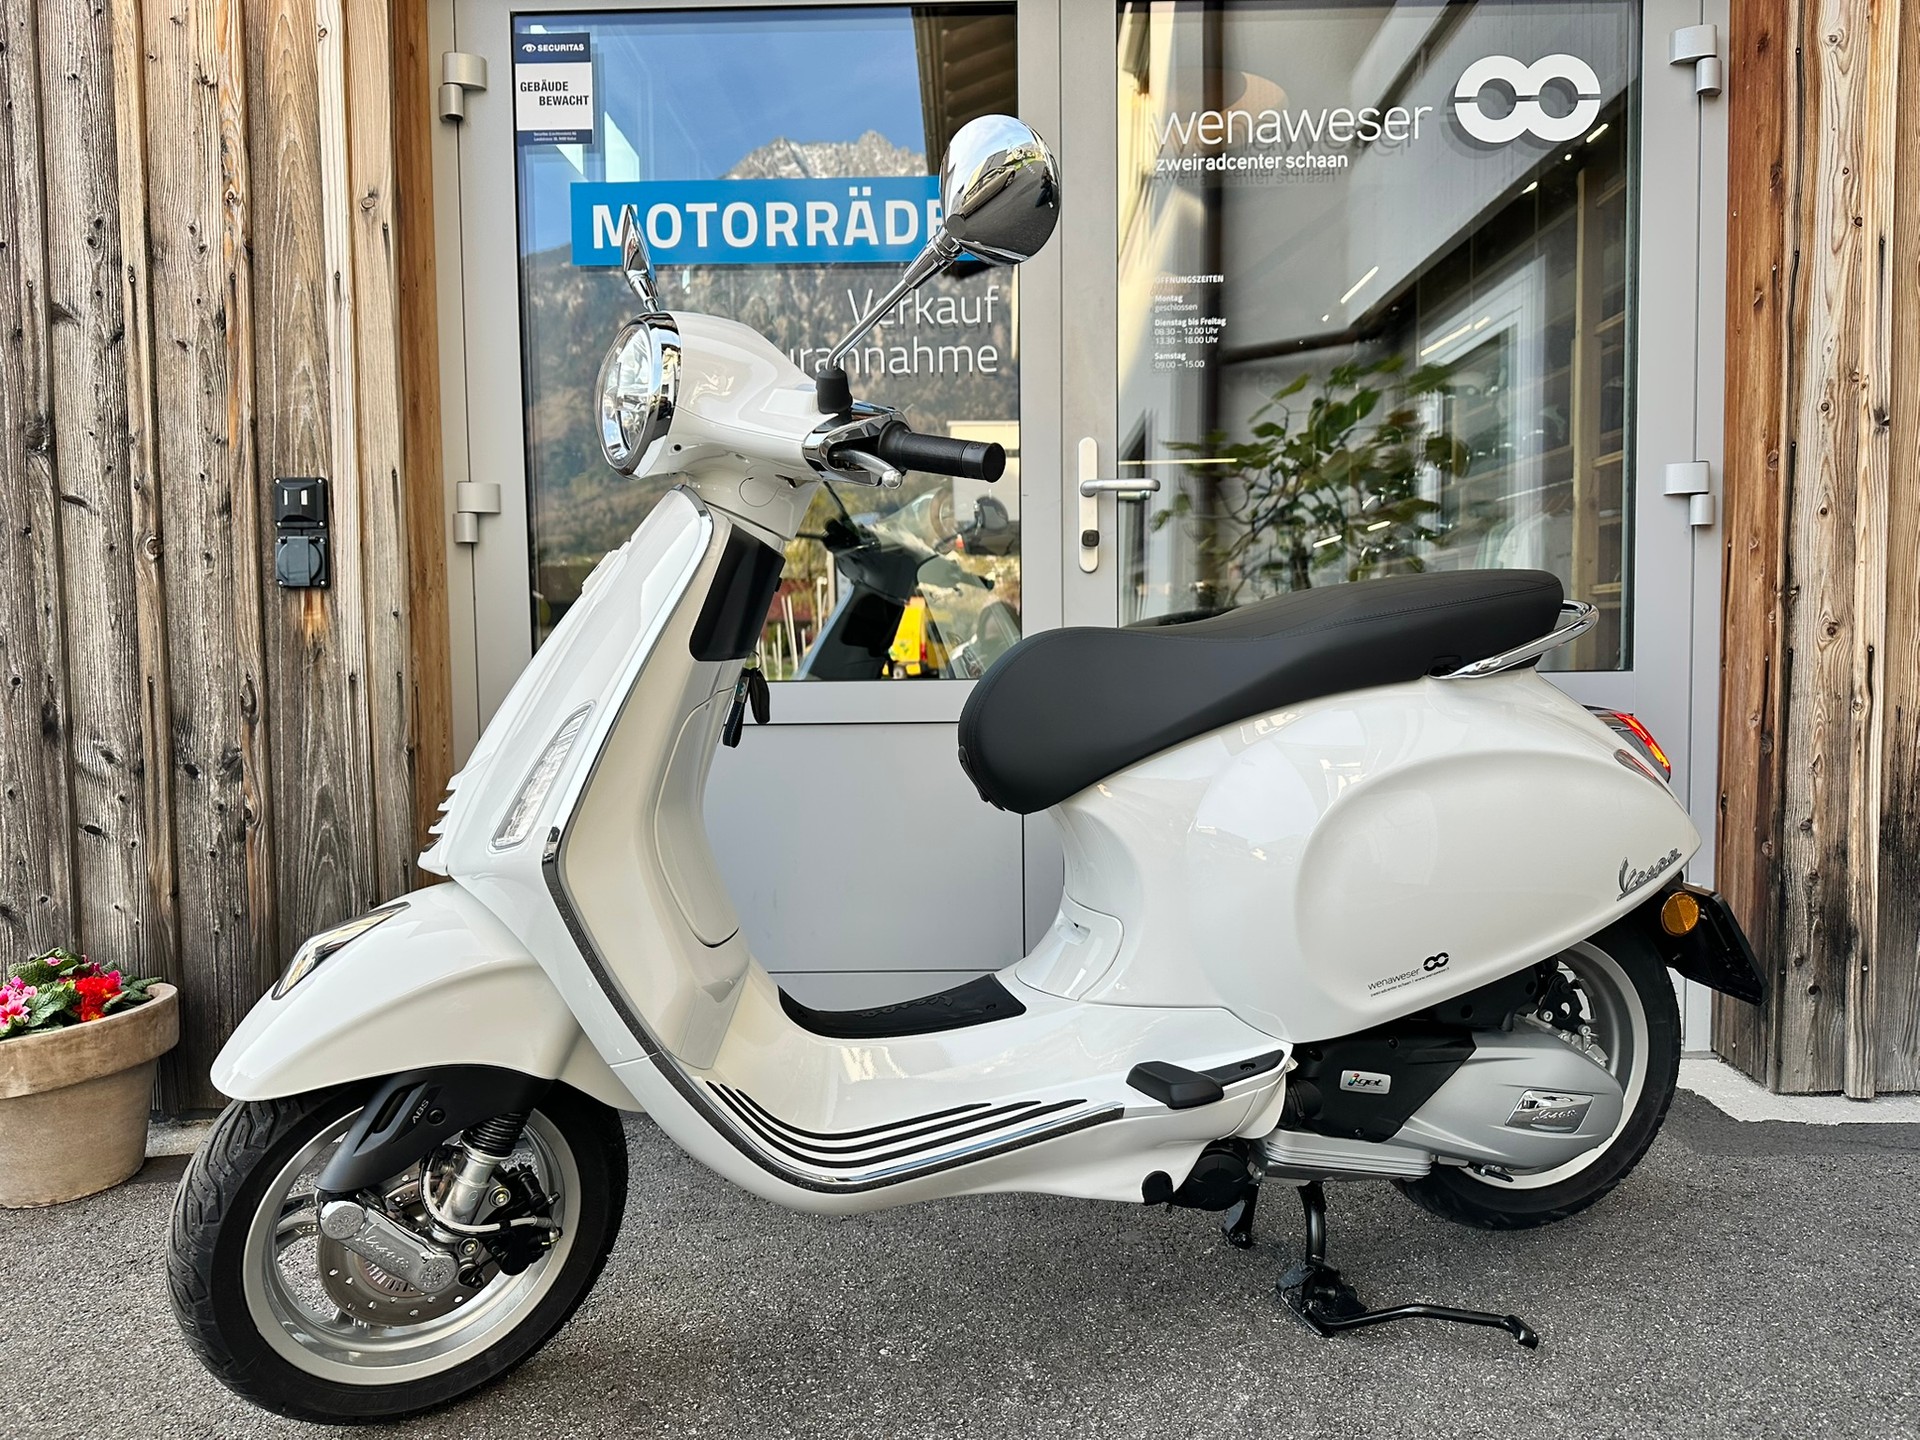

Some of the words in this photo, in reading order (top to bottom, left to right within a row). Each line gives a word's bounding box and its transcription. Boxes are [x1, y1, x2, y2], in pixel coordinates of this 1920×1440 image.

[537, 43, 585, 52] SECURITAS
[520, 79, 569, 92] GEBÄUDE
[539, 95, 589, 106] BEWACHT
[1153, 105, 1433, 146] wenaweser
[1156, 153, 1282, 172] zweiradcenter
[1285, 151, 1348, 169] schaan
[1154, 295, 1184, 303] Montag
[1154, 303, 1198, 313] geschlossen
[1154, 318, 1187, 328] Dienstag
[1187, 317, 1199, 326] bis
[1200, 316, 1227, 327] Freitag
[1184, 326, 1204, 335] 12.00
[1205, 326, 1219, 335] Uhr
[1205, 335, 1219, 344] Uhr
[1154, 352, 1187, 361] Samstag
[1184, 360, 1205, 368] 15.00
[1616, 848, 1682, 901] Vespa
[1367, 967, 1421, 991] wenaweser
[412, 1099, 429, 1124] ABS
